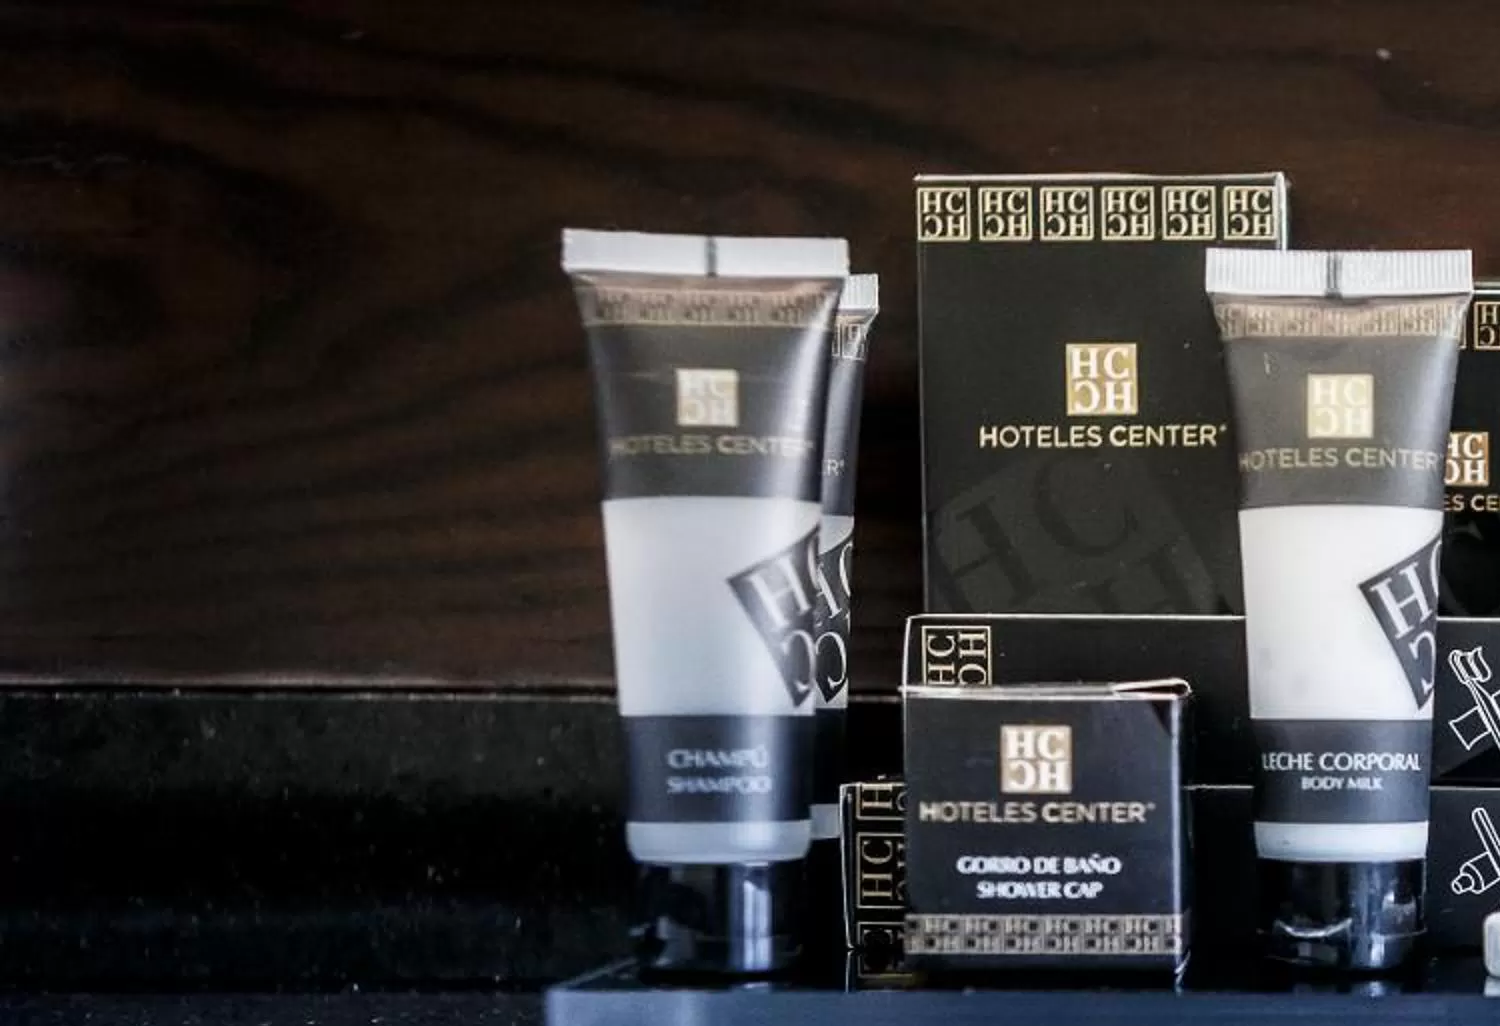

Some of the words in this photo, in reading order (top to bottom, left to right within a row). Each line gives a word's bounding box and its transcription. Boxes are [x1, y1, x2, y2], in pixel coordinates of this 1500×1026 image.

[1072, 350, 1130, 379] HC
[609, 436, 712, 455] HOTELES
[979, 425, 1102, 448] HOTELES
[1240, 448, 1338, 470] HOTELES
[1262, 752, 1314, 771] LECHE
[1320, 752, 1420, 772] CORPORAL
[667, 775, 772, 796] SHAMPOO
[1302, 777, 1344, 791] BODY
[1348, 777, 1382, 791] MILK
[919, 802, 1037, 823] HOTELES
[956, 856, 1029, 875] GORRO
[1034, 856, 1061, 875] DE
[1064, 852, 1122, 875] BAÑO
[977, 881, 1061, 899] SHOWER
[1064, 881, 1103, 899] CAP
